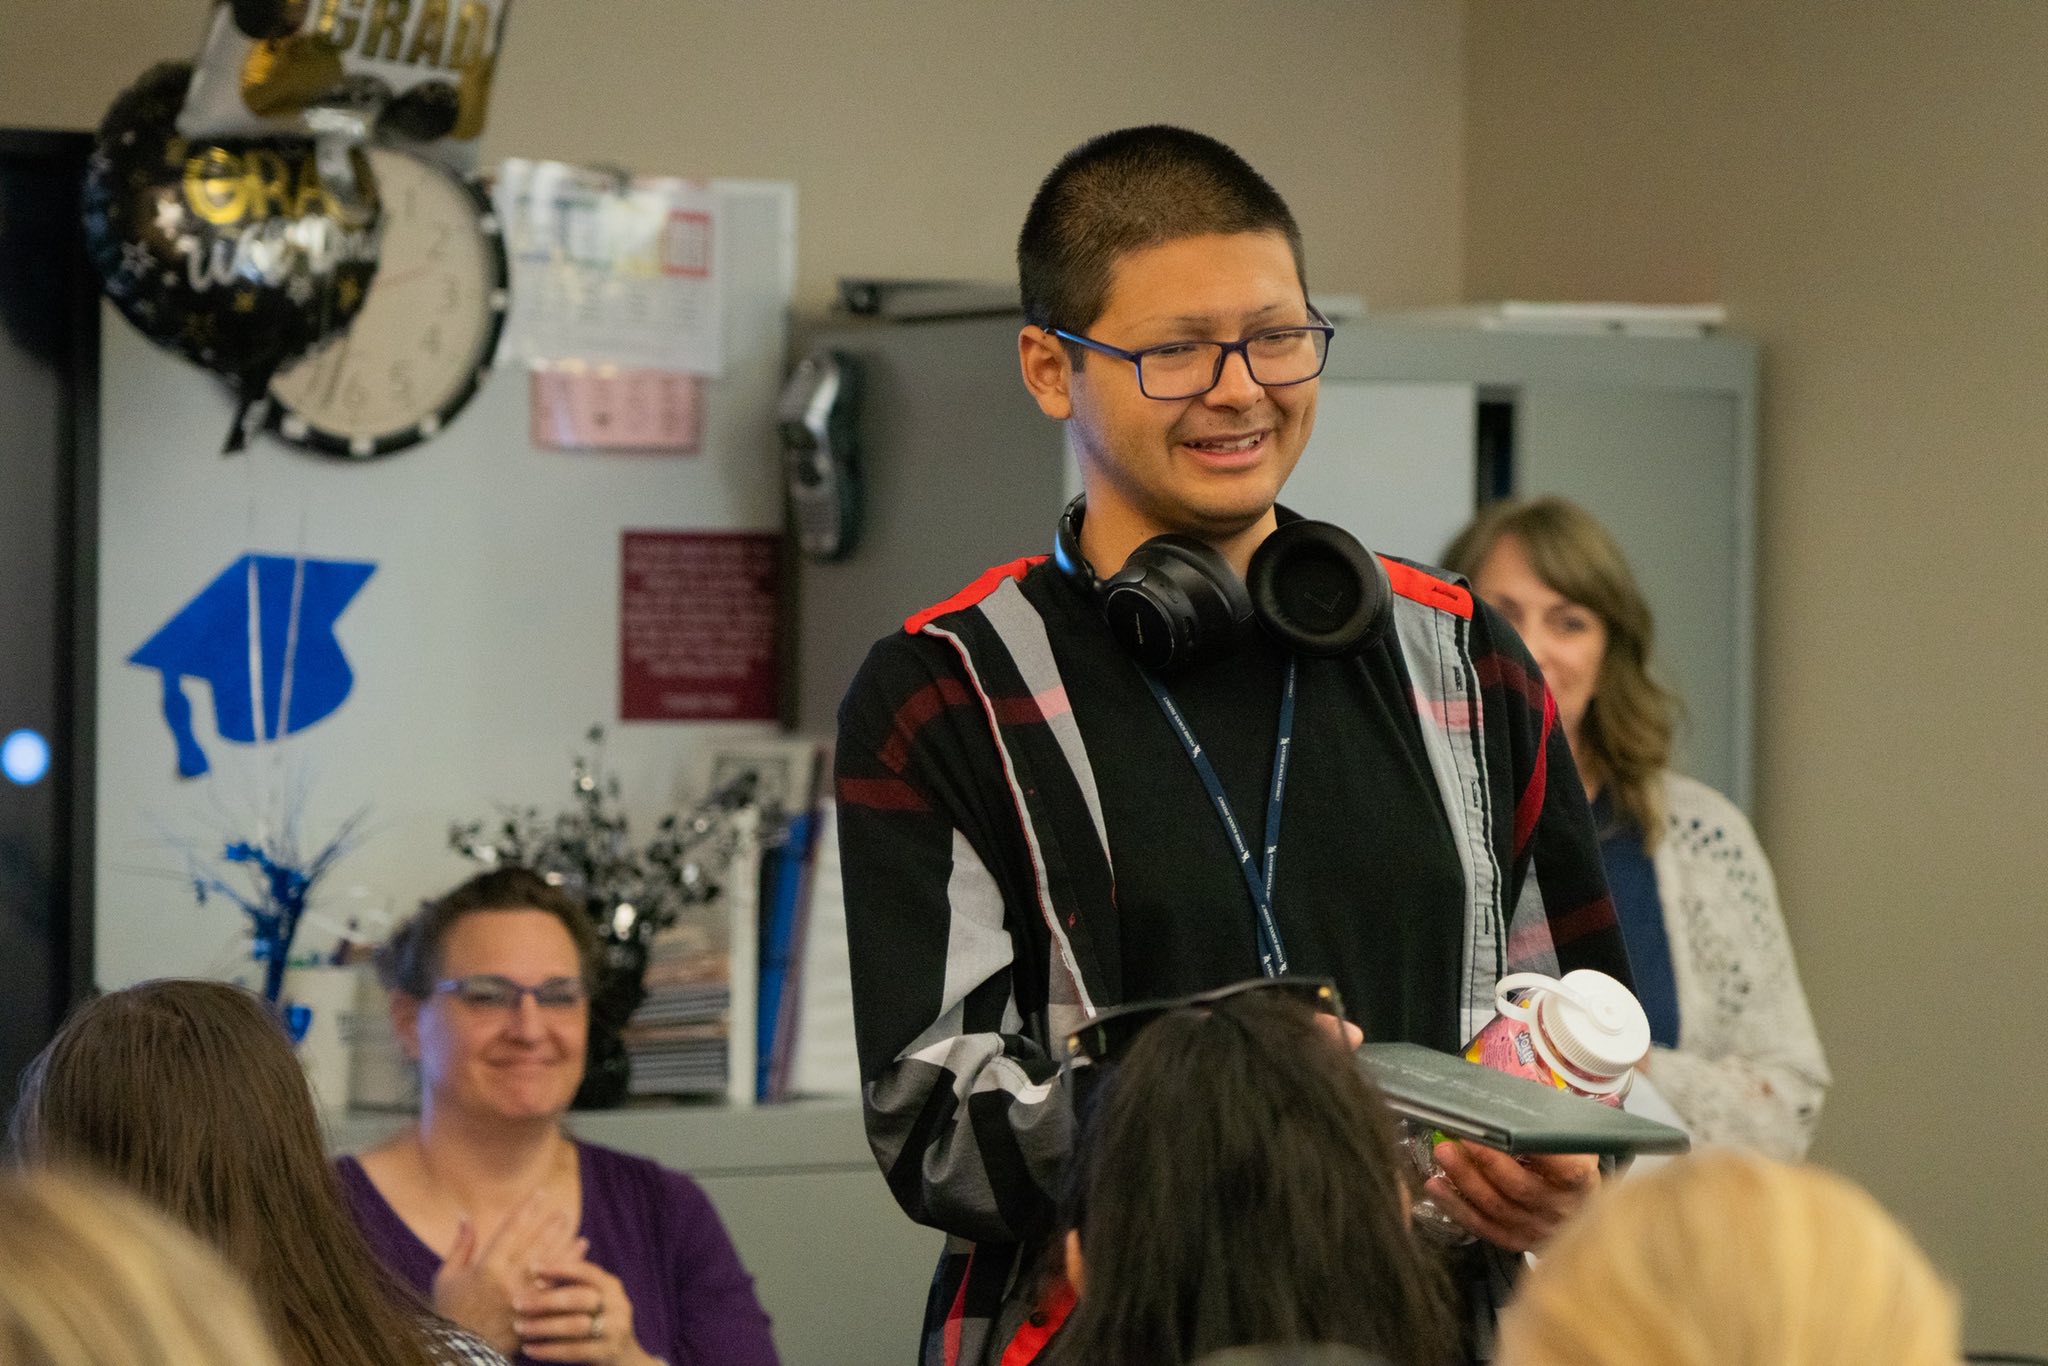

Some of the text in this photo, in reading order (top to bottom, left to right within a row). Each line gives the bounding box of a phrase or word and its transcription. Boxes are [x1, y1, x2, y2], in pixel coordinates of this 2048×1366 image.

[427, 220, 451, 262] 2
[437, 273, 459, 315] 3
[1163, 697, 1176, 715] DISTRICT
[1175, 715, 1186, 731] SCHOOL
[1218, 797, 1230, 816] DISTRICT
[1227, 816, 1237, 833] SCHOOL
[1262, 905, 1272, 925] DISTRICT
[1269, 926, 1278, 944] SCHOOL
